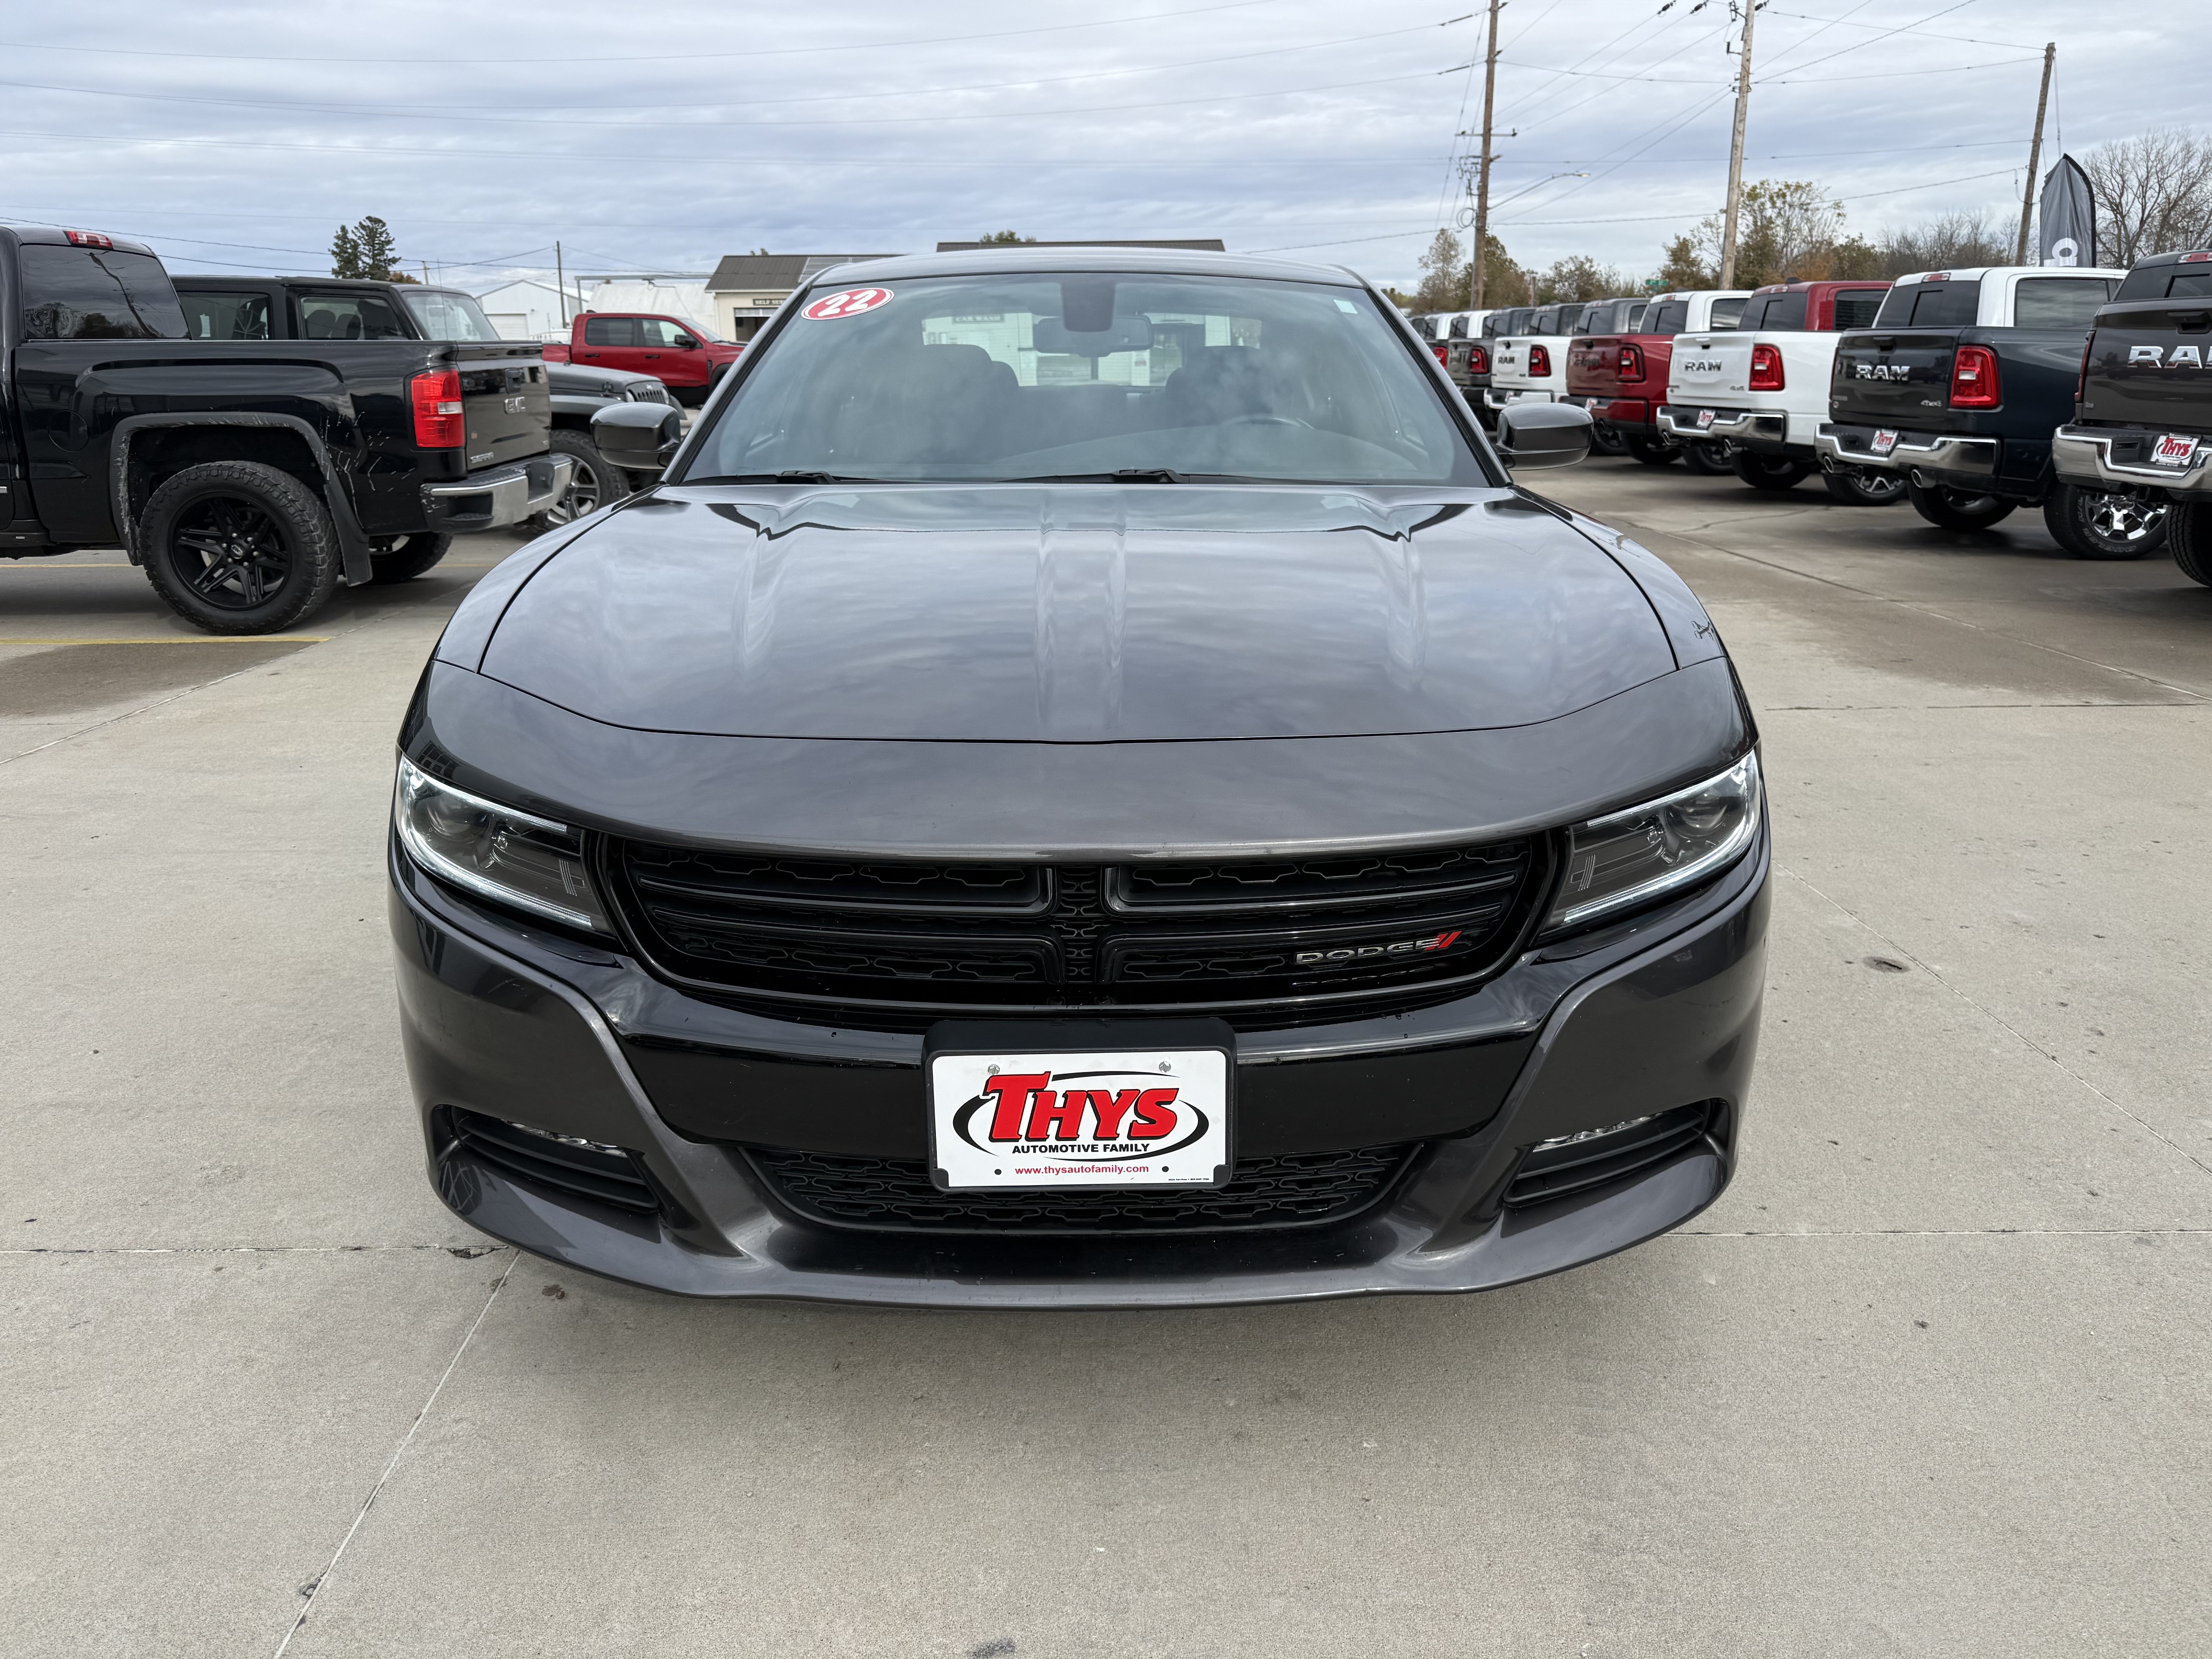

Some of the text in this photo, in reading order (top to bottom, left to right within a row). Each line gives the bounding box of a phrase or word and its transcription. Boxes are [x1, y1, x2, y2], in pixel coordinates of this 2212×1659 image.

[817, 290, 878, 317] 22
[1498, 356, 1515, 364] RAM
[1685, 360, 1722, 372] RAM
[2127, 346, 2212, 369] RA
[1855, 365, 1910, 381] RAM
[2160, 437, 2192, 457] THYS
[1295, 938, 1441, 963] DODGE
[985, 1071, 1180, 1141] THYS
[1012, 1143, 1150, 1154] AUTOMOTIVE FAMILY
[1015, 1164, 1149, 1176] www.thysautofamily.com
